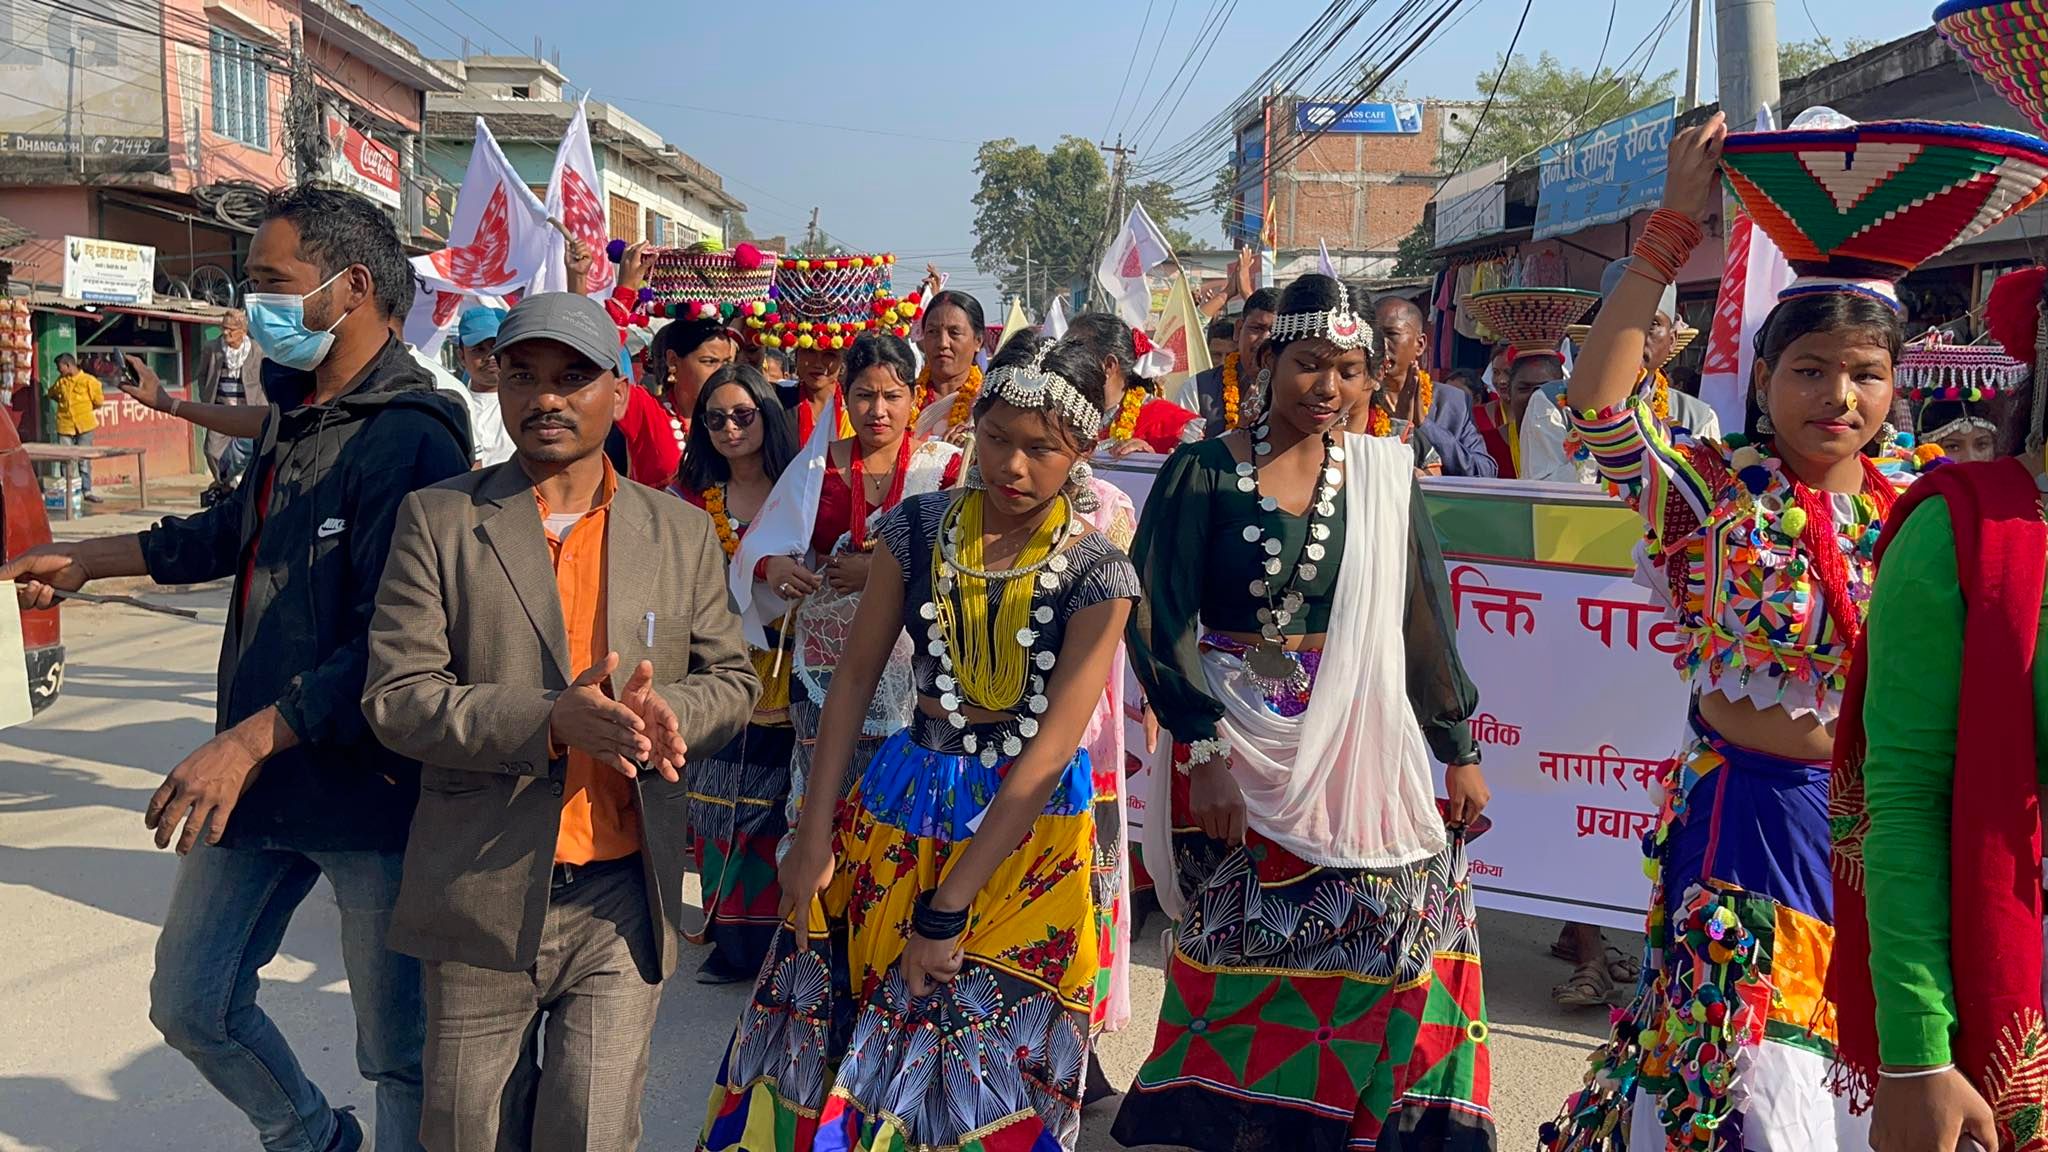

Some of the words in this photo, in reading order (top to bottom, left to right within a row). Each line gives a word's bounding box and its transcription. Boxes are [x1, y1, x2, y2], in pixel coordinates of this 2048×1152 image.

[323, 517, 346, 529] NIKE
[1538, 744, 1662, 792] नागरिक
[1576, 805, 1661, 840] प्रचार
